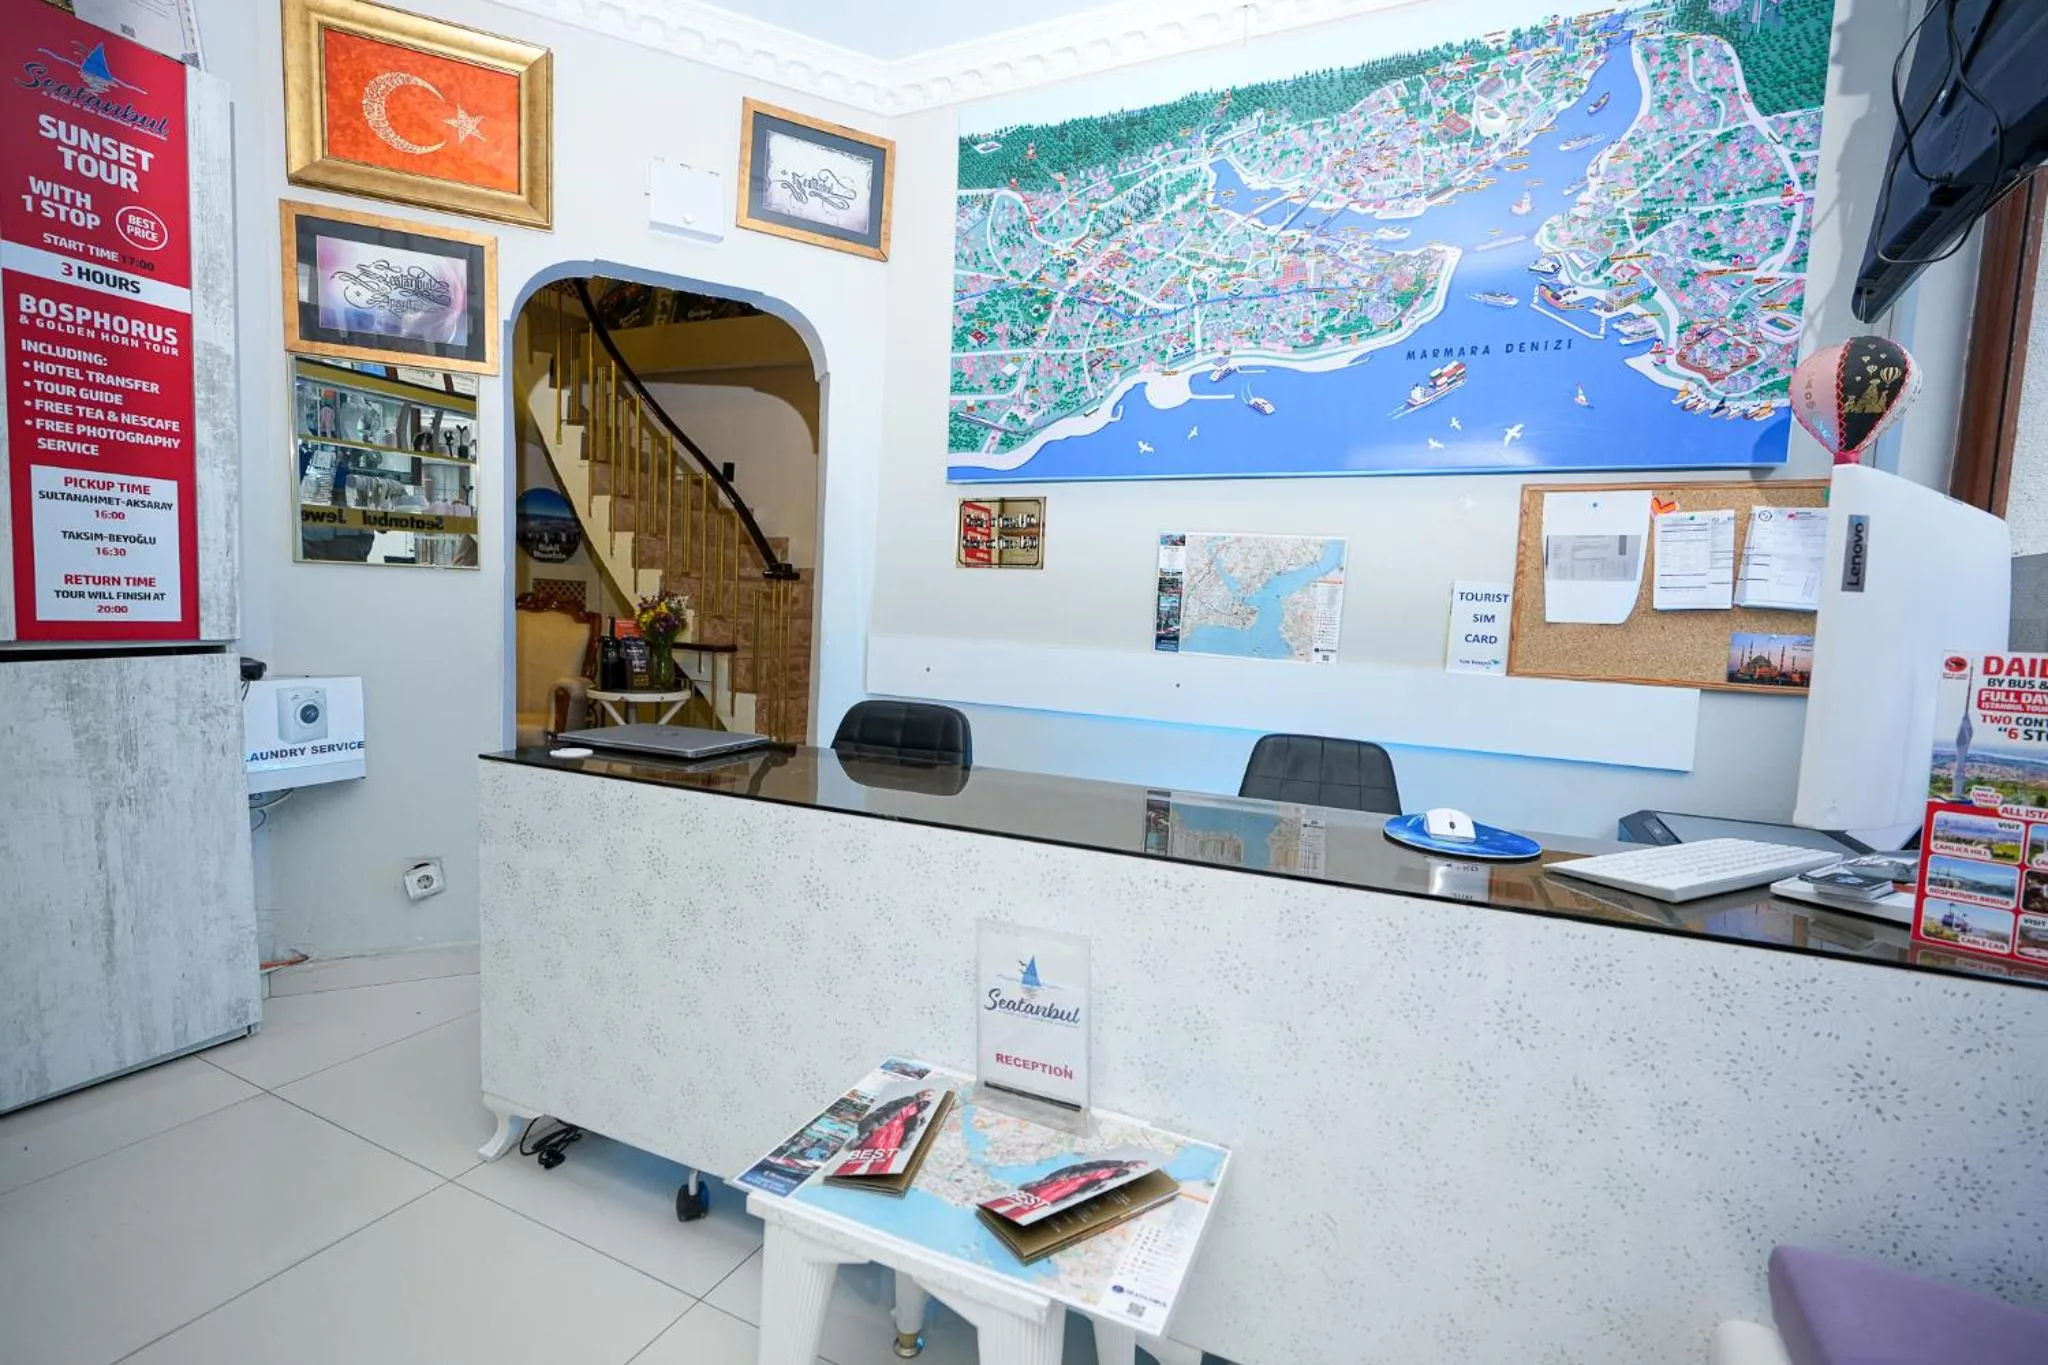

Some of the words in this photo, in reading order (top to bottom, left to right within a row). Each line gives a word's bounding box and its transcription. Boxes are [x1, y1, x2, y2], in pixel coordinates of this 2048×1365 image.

[37, 113, 155, 172] SUNSET
[56, 145, 140, 193] TOUR
[28, 176, 92, 210] WITH
[21, 195, 34, 213] 1
[41, 201, 101, 230] STOP
[127, 214, 157, 232] BEST
[126, 225, 159, 243] PRICE
[42, 232, 85, 253] START
[87, 245, 119, 262] TIME
[121, 254, 155, 272] 17:00
[60, 262, 73, 277] 3
[77, 266, 141, 294] HOURS
[18, 293, 179, 346] BOSPHORUS
[18, 314, 29, 326] &
[35, 317, 96, 339] GOLDEN
[101, 331, 139, 349] HORN
[144, 341, 179, 357] TOUR
[21, 338, 108, 367] INCLUDING:
[1406, 345, 1490, 360] MARMARA
[33, 360, 84, 381] HOTEL
[86, 370, 160, 395] TRANSFER
[34, 380, 77, 398] TOUR
[78, 386, 124, 406] GUIDE
[35, 399, 73, 418] FREE
[76, 404, 104, 422] TEA
[106, 410, 118, 422] &
[121, 412, 180, 433] NESCAFE
[35, 419, 74, 436] FREE
[76, 423, 181, 450] PHOTOGRAPHY
[37, 437, 99, 457] SERVICE
[63, 476, 116, 493] PICKUP
[118, 482, 151, 496] TIME
[38, 490, 174, 512] SULTANAHMET-AKSARAY
[94, 509, 126, 521] 16:00
[95, 546, 127, 558] 16:30
[1847, 522, 1864, 586] Lenovo
[64, 573, 121, 588] RETURN
[123, 575, 157, 588] TIME
[54, 589, 87, 601] TOUR
[87, 590, 115, 601] WILL
[116, 590, 152, 602] FINISH
[152, 591, 166, 602] AT
[1459, 592, 1509, 603] TOURIST
[97, 604, 129, 615] 20:00
[1473, 614, 1495, 623] SIM
[1464, 634, 1498, 644] CARD
[1987, 678, 2005, 687] BY
[2008, 679, 2035, 689] BUS
[1981, 690, 2018, 703] FULL
[1981, 714, 2012, 725] TWO
[2023, 728, 2048, 741] ST
[311, 741, 366, 755] SERVICE
[2002, 806, 2022, 816] ALL
[1998, 822, 2021, 830] VISIT
[2024, 917, 2046, 927] VISIT
[984, 988, 1080, 1024] Seatanbul
[995, 1052, 1074, 1080] RECEPTION
[848, 1148, 898, 1160] BEST
